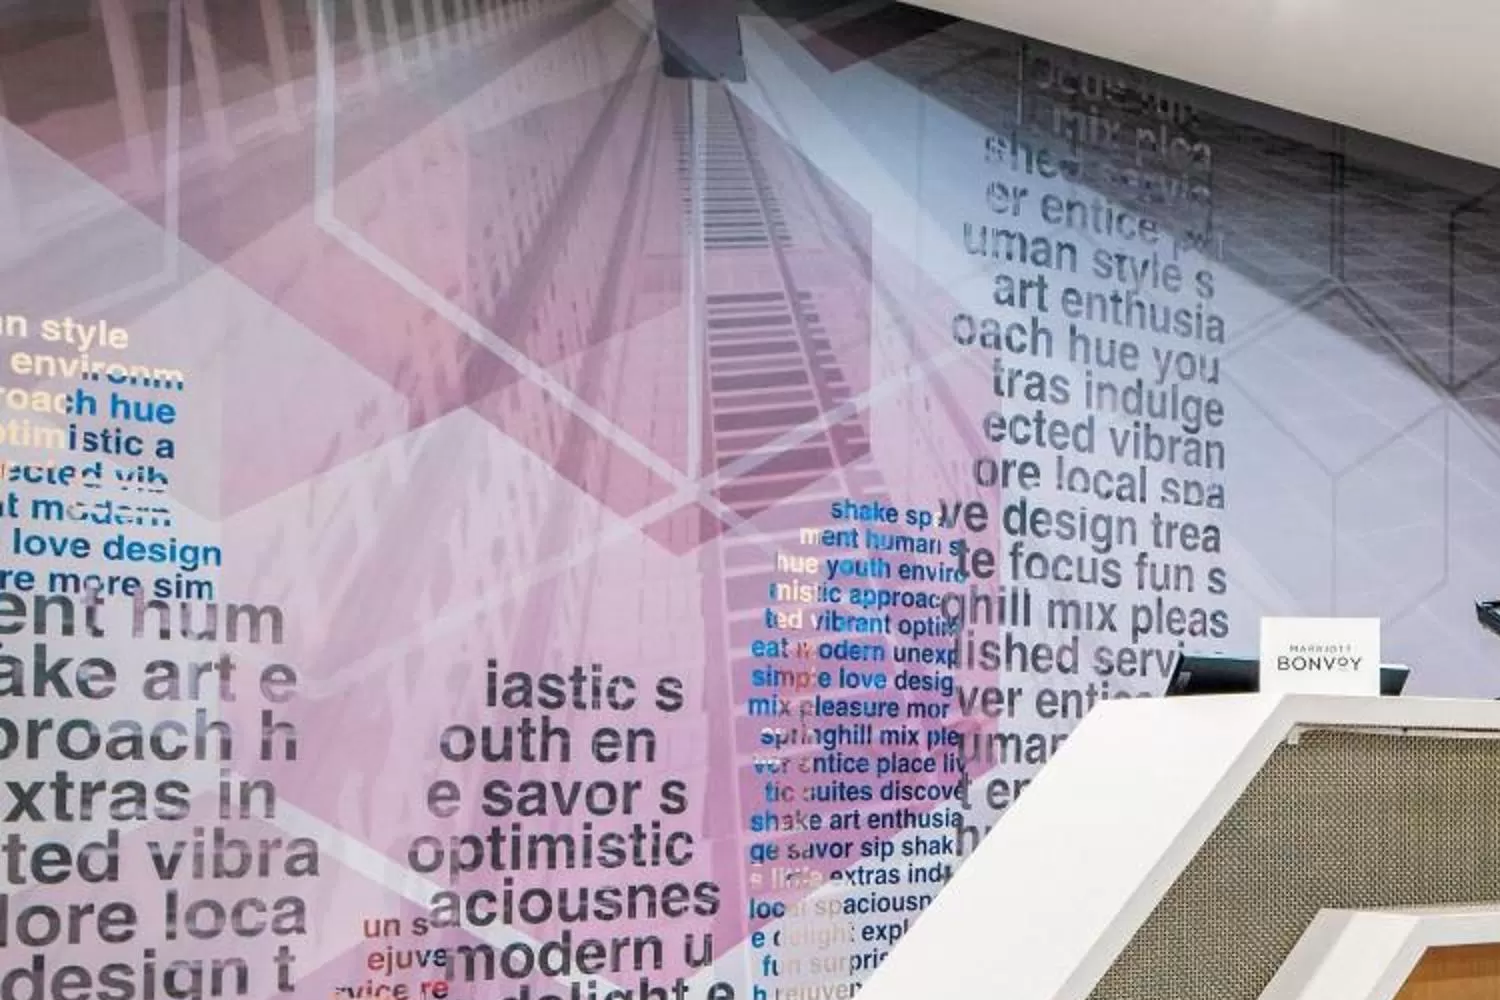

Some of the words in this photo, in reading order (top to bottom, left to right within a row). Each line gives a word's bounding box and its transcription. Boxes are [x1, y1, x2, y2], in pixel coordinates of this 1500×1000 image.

[985, 181, 1029, 217] er
[1041, 193, 1160, 244] entice
[963, 222, 1078, 273] uman
[1092, 247, 1183, 294] style
[1195, 268, 1215, 300] s
[993, 273, 1049, 313] art
[1061, 284, 1226, 345] enthusia
[41, 319, 129, 352] style
[951, 312, 1053, 359] oach
[1069, 323, 1141, 372] hue
[1152, 346, 1220, 386] you
[11, 350, 185, 391] environm
[111, 392, 177, 425] hue
[993, 357, 1071, 406] tras
[1084, 369, 1226, 434] indulge
[155, 438, 175, 460] a
[983, 408, 1096, 455] ected
[1109, 419, 1226, 471] vibran
[973, 455, 1041, 491] ore
[1055, 454, 1148, 504] local
[31, 497, 171, 528] modern
[830, 500, 899, 524] shake
[1002, 496, 1138, 555] design
[1151, 510, 1222, 554] trea
[13, 528, 92, 560] love
[103, 535, 222, 572] design
[800, 526, 859, 550] ment
[866, 528, 942, 555] human
[50, 571, 142, 597] more
[154, 573, 214, 601] sim
[775, 550, 819, 575] hue
[826, 556, 892, 581] youth
[958, 538, 995, 580] te
[1008, 540, 1123, 589] focus
[1135, 551, 1195, 594] fun
[1207, 565, 1228, 595] s
[131, 585, 284, 645] hum
[764, 607, 804, 631] ted
[811, 609, 891, 635] vibrant
[940, 583, 1031, 634] ghill
[1047, 597, 1118, 634] mix
[1130, 596, 1230, 644] pleas
[751, 637, 789, 659] eat
[1277, 655, 1362, 672] BONVOY
[143, 650, 237, 703] art
[259, 662, 298, 704] e
[485, 658, 638, 712] iastic
[654, 675, 685, 713] s
[839, 666, 888, 690] love
[893, 670, 955, 697] desig
[748, 693, 791, 717] mix
[800, 695, 900, 721] pleasure
[906, 701, 950, 718] mor
[956, 684, 1023, 719] ver
[260, 709, 298, 762] h
[439, 714, 572, 763] outh
[590, 724, 657, 763] en
[760, 722, 873, 751] springhill
[878, 725, 919, 747] mix
[926, 726, 961, 749] ple
[799, 751, 870, 774] entice
[876, 752, 937, 778] place
[943, 752, 966, 774] liv
[3, 769, 192, 823] xtras
[218, 767, 277, 820] in
[426, 779, 462, 819] e
[480, 777, 643, 818] savor
[658, 778, 690, 816] s
[765, 780, 795, 802] tic
[880, 779, 968, 802] discove
[750, 809, 823, 833] shake
[829, 809, 862, 830] art
[867, 806, 965, 831] enthusia
[2, 828, 121, 885] ted
[146, 826, 321, 882] vibra
[407, 819, 695, 885] optimistic
[750, 840, 779, 865] ge
[787, 838, 854, 860] savor
[860, 834, 895, 862] sip
[901, 834, 955, 859] shak
[164, 888, 307, 942] loca
[428, 876, 721, 929] aciousnes
[363, 916, 401, 938] un
[410, 914, 430, 937] s
[751, 929, 766, 950] e
[273, 944, 297, 993] t
[366, 945, 449, 977] ejuve
[443, 929, 664, 983] modern
[682, 932, 714, 969] u
[762, 954, 802, 978] fun
[419, 979, 449, 1000] re
